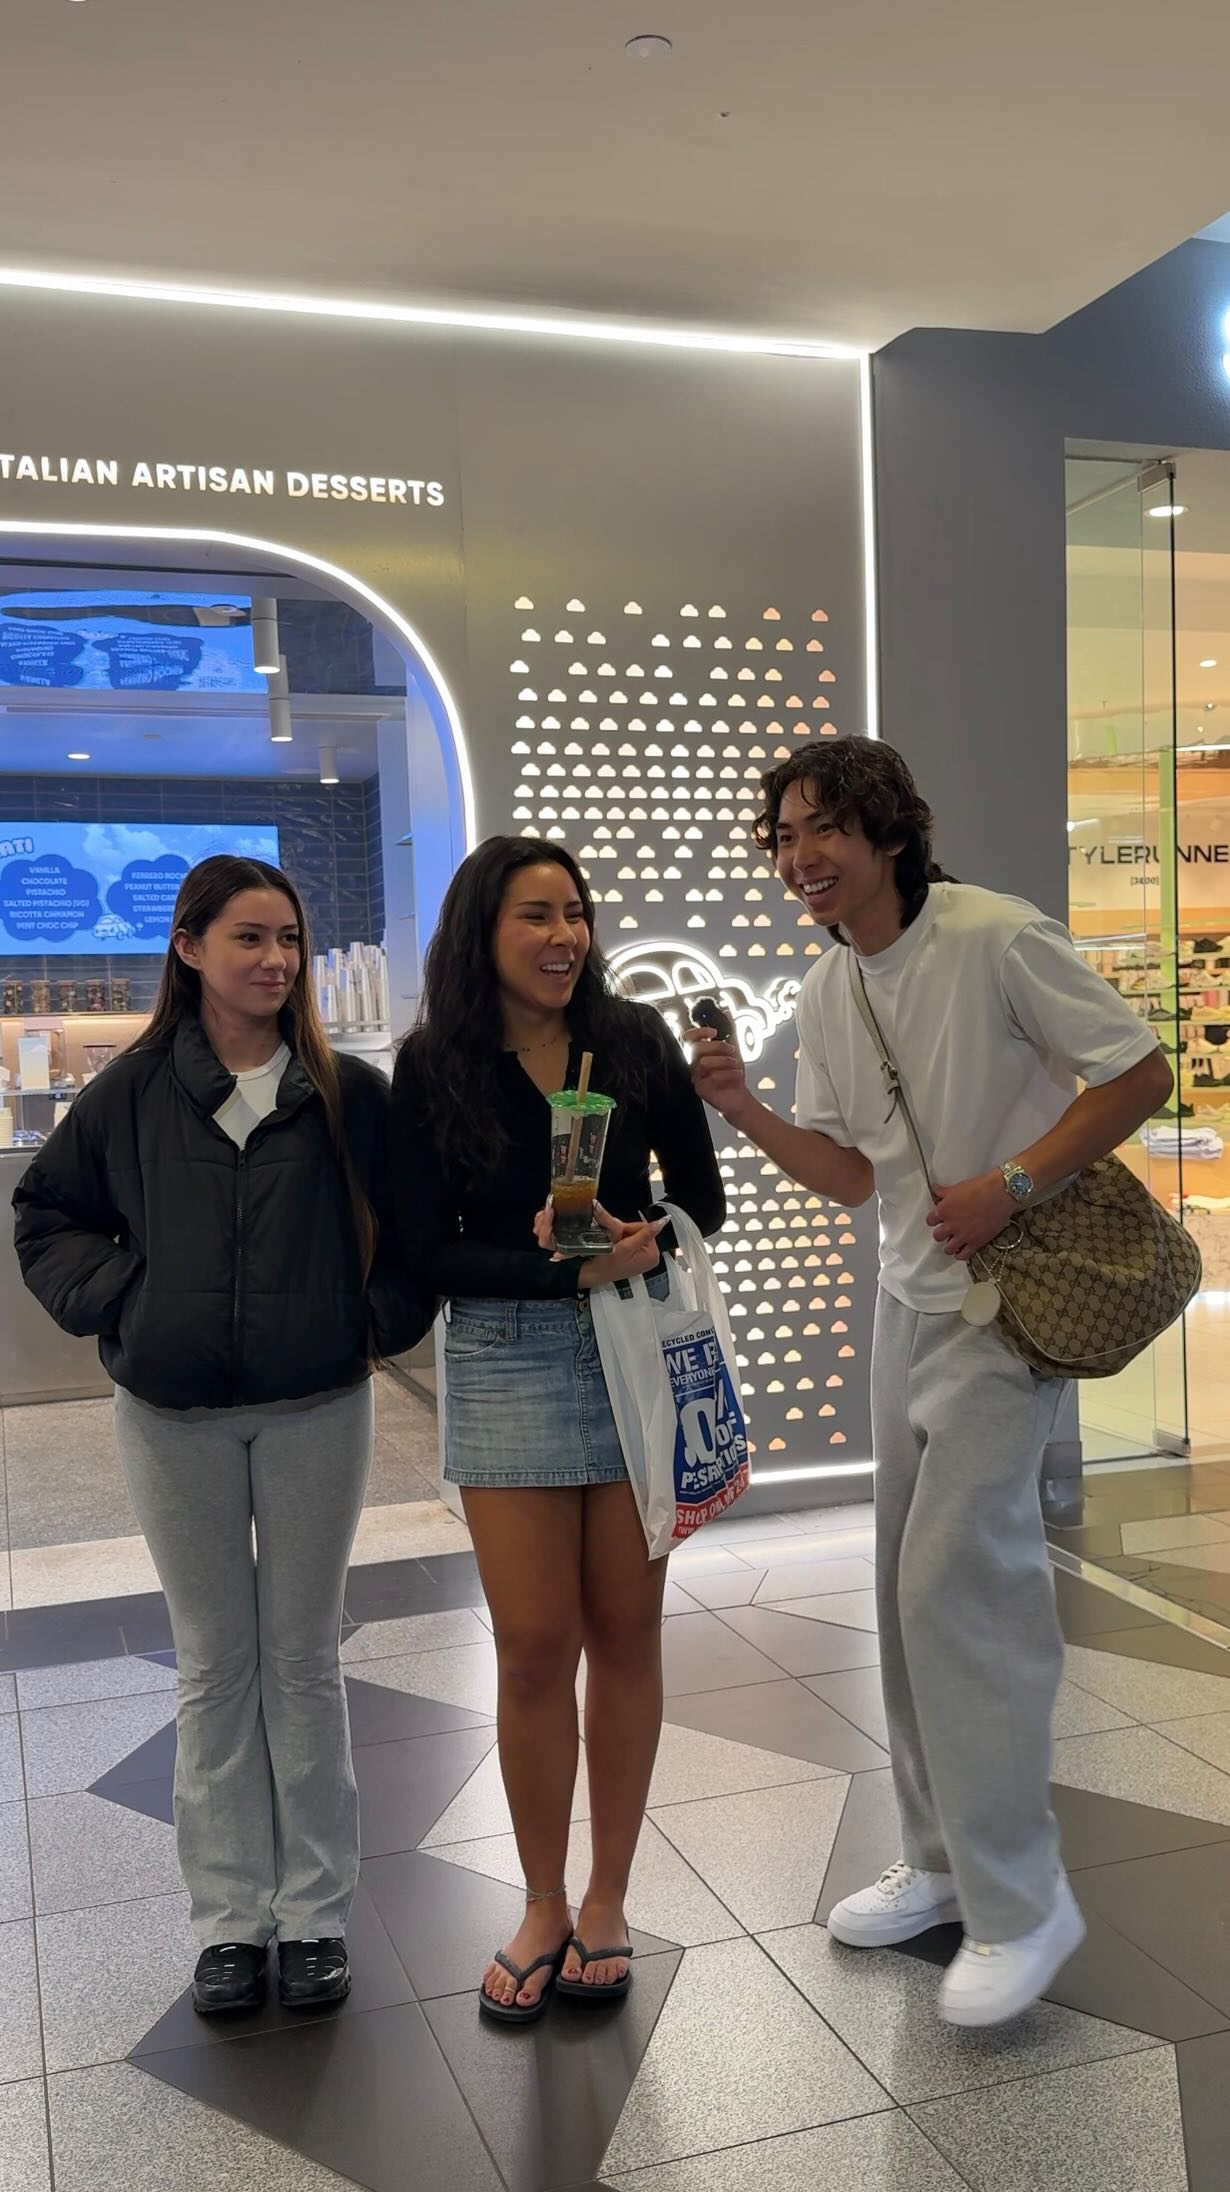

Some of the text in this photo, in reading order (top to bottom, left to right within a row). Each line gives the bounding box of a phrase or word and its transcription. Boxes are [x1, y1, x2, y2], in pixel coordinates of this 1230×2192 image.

[131, 462, 275, 496] ARTISAN
[286, 471, 445, 507] DESSERTS
[29, 866, 60, 874] VANILLA
[21, 877, 68, 885] CHOCOLATE
[26, 888, 67, 896] PISTACHIO
